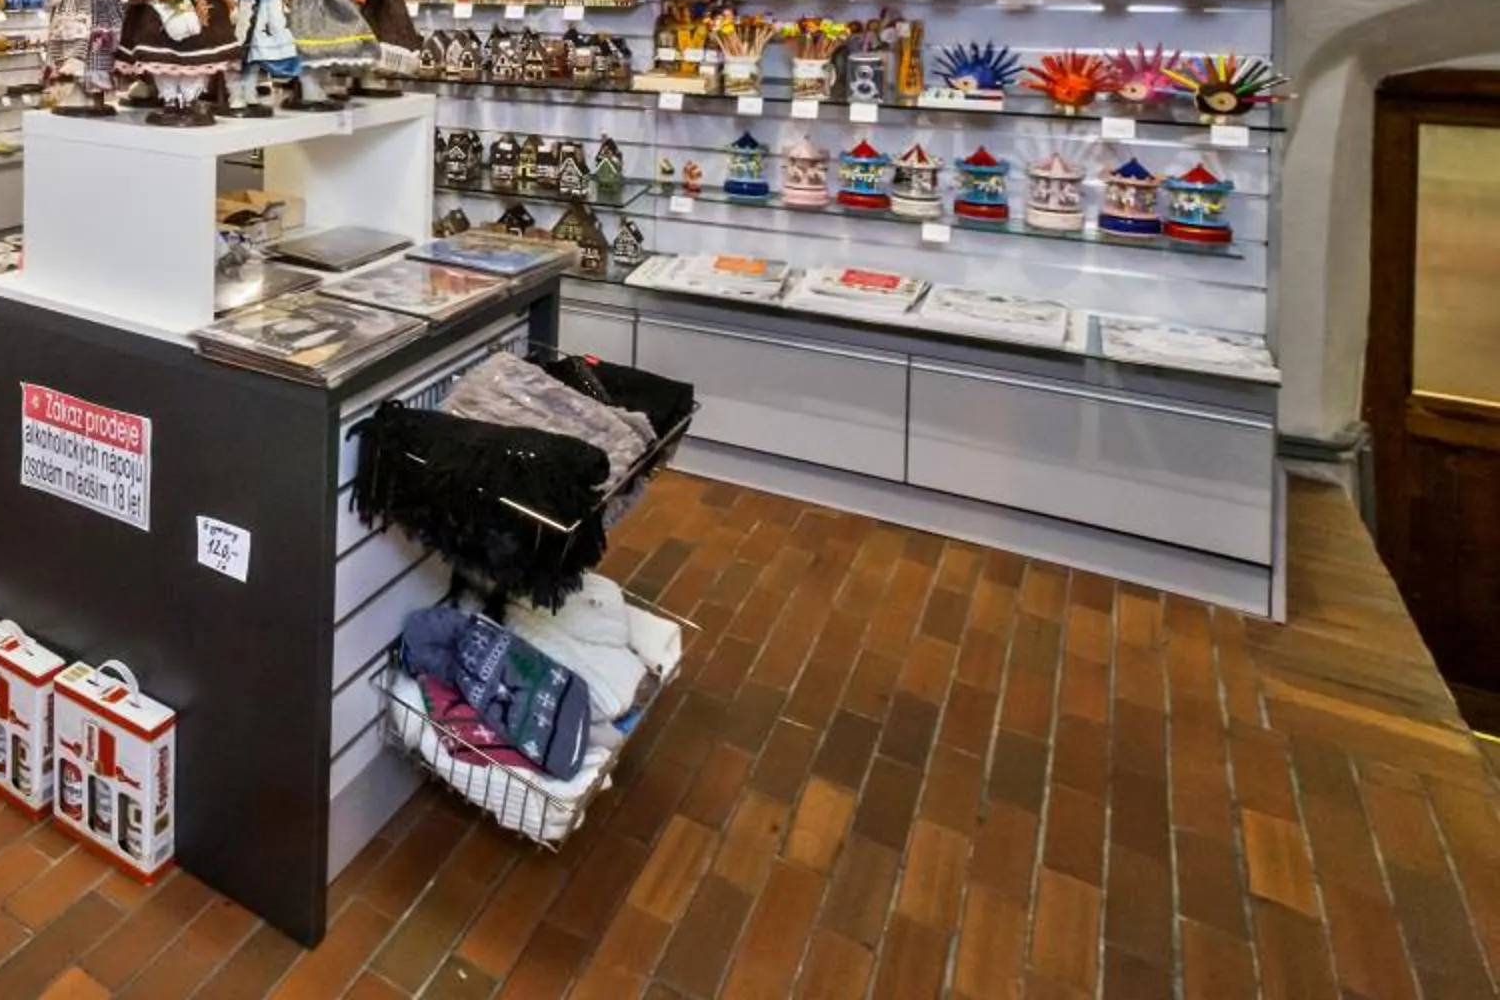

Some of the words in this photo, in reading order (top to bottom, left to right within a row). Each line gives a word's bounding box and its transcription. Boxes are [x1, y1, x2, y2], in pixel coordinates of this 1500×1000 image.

[45, 392, 83, 428] Zákaz
[86, 411, 140, 448] prodeje
[25, 423, 99, 469] alkoholických
[112, 483, 125, 511] 18
[128, 485, 141, 518] let
